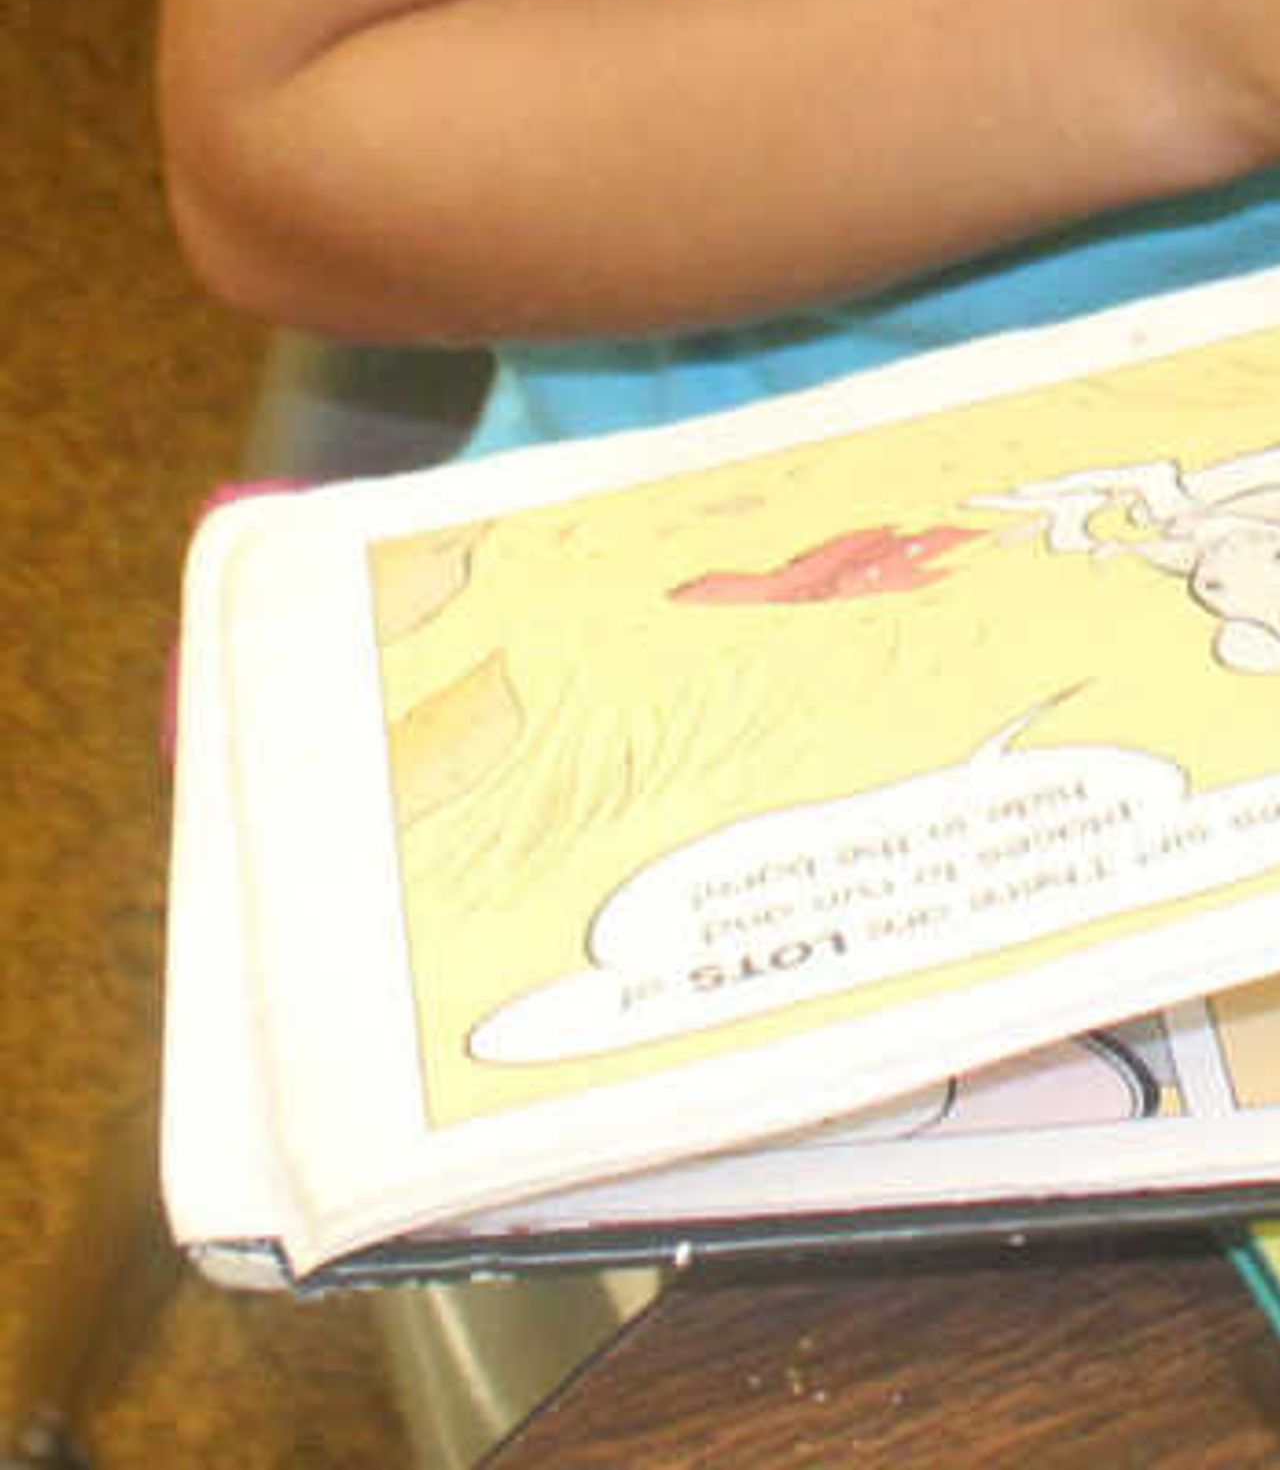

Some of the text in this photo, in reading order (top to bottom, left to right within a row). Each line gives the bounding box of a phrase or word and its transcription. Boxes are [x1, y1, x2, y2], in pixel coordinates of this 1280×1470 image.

[984, 780, 1089, 825] hide
[927, 814, 968, 844] in
[701, 798, 1134, 946] places to run and
[835, 833, 911, 870] the
[968, 857, 1108, 912] There
[865, 905, 950, 942] are
[686, 930, 851, 994] LOTS
[619, 976, 668, 1012] of
